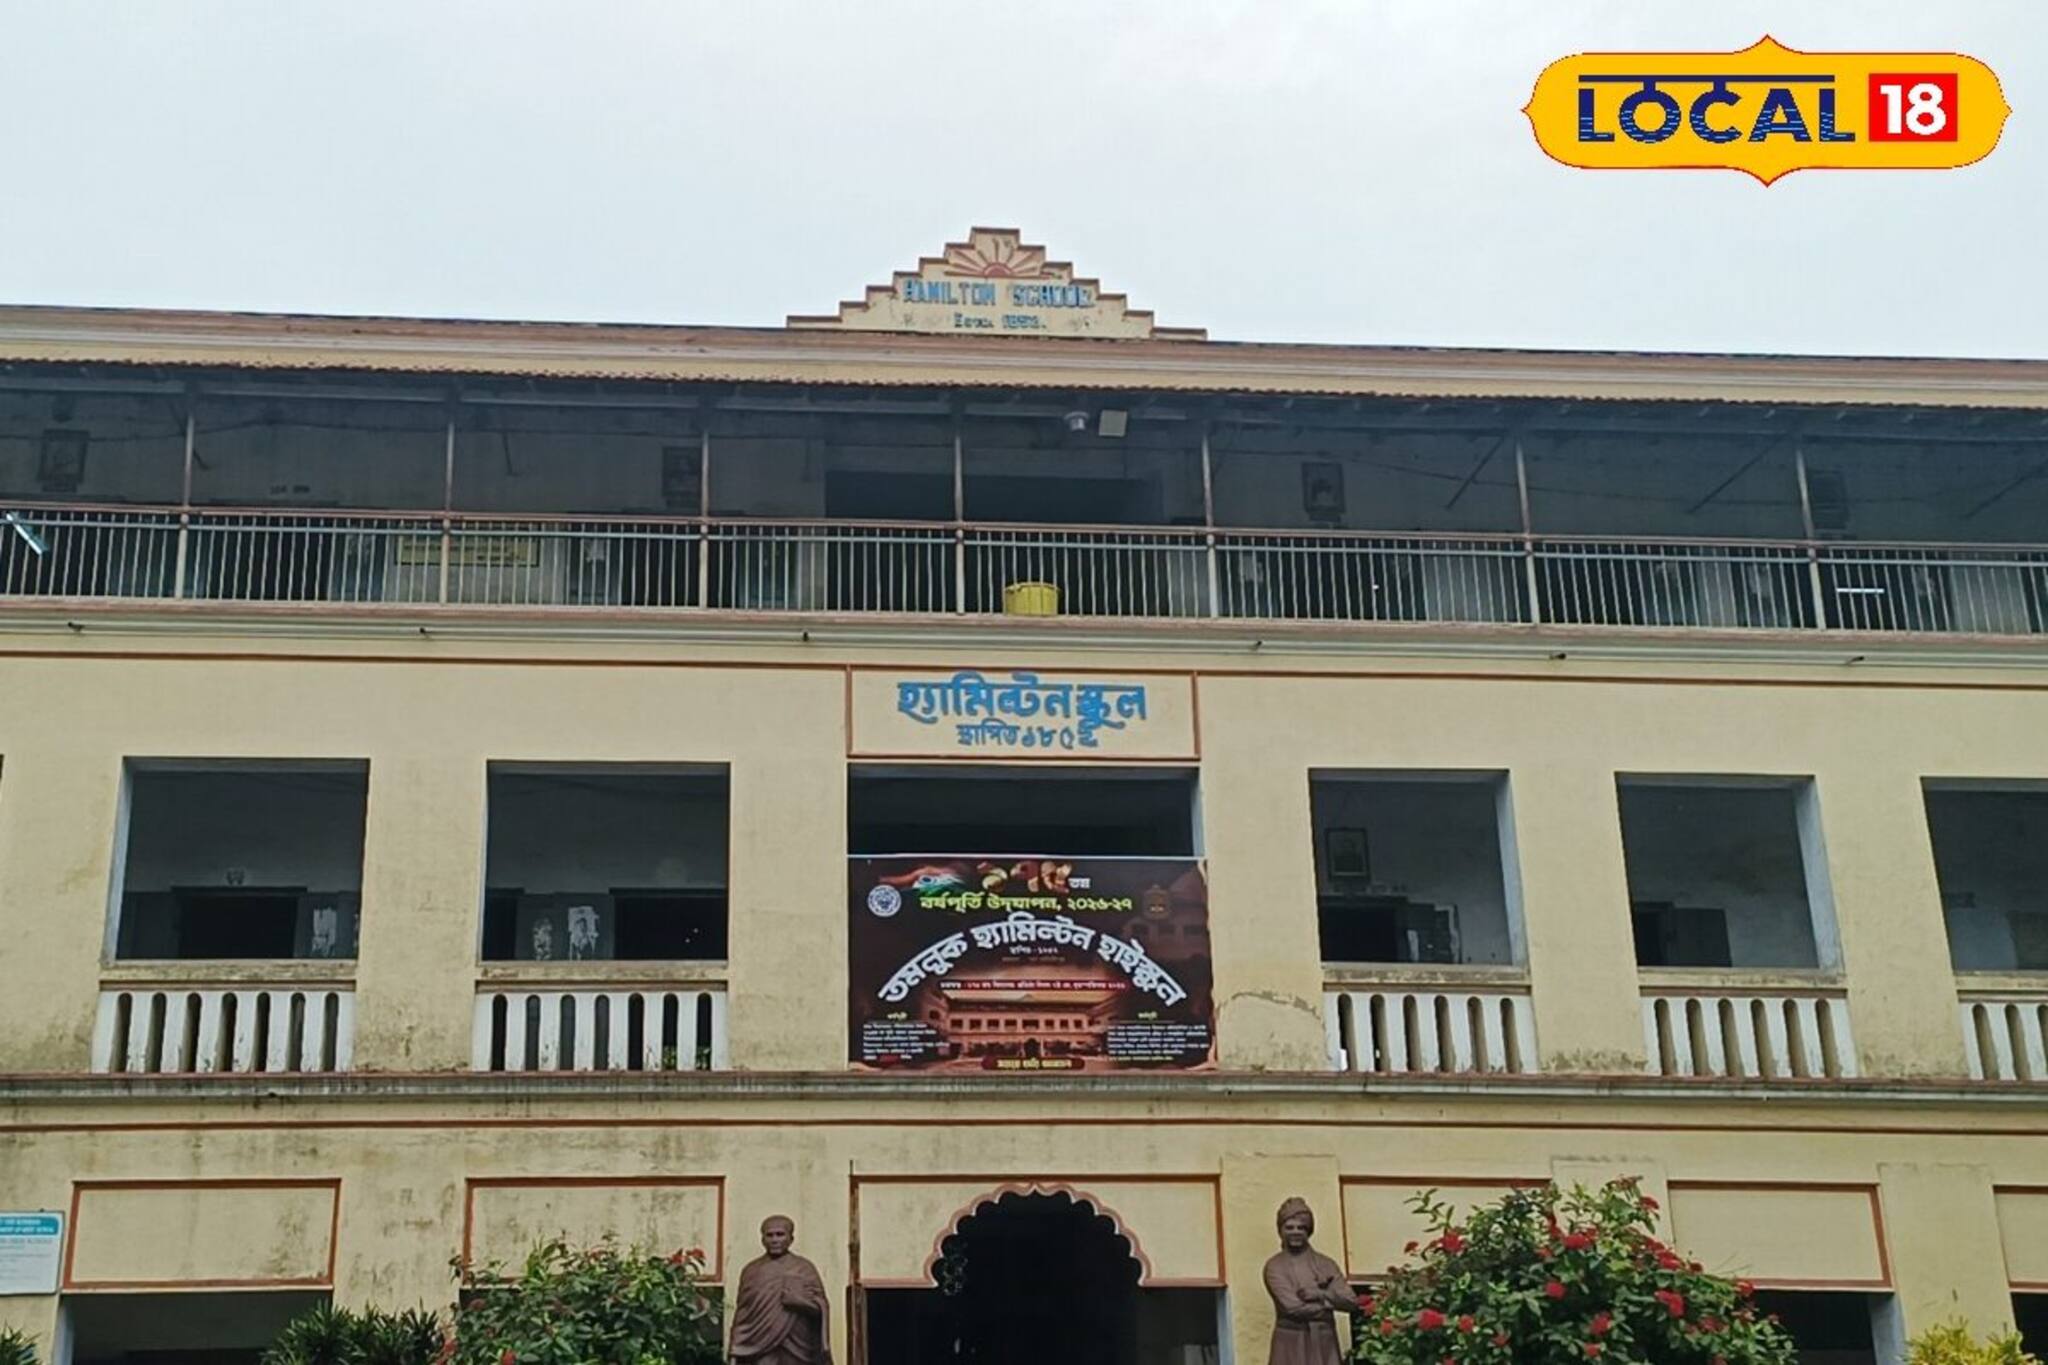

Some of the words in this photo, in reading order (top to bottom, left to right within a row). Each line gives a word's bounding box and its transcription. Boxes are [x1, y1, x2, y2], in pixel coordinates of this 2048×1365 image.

[920, 891, 985, 914] বর্ষপূর্তি
[878, 932, 968, 1002] তমলুক
[1097, 934, 1188, 1007] হাইস্কুল
